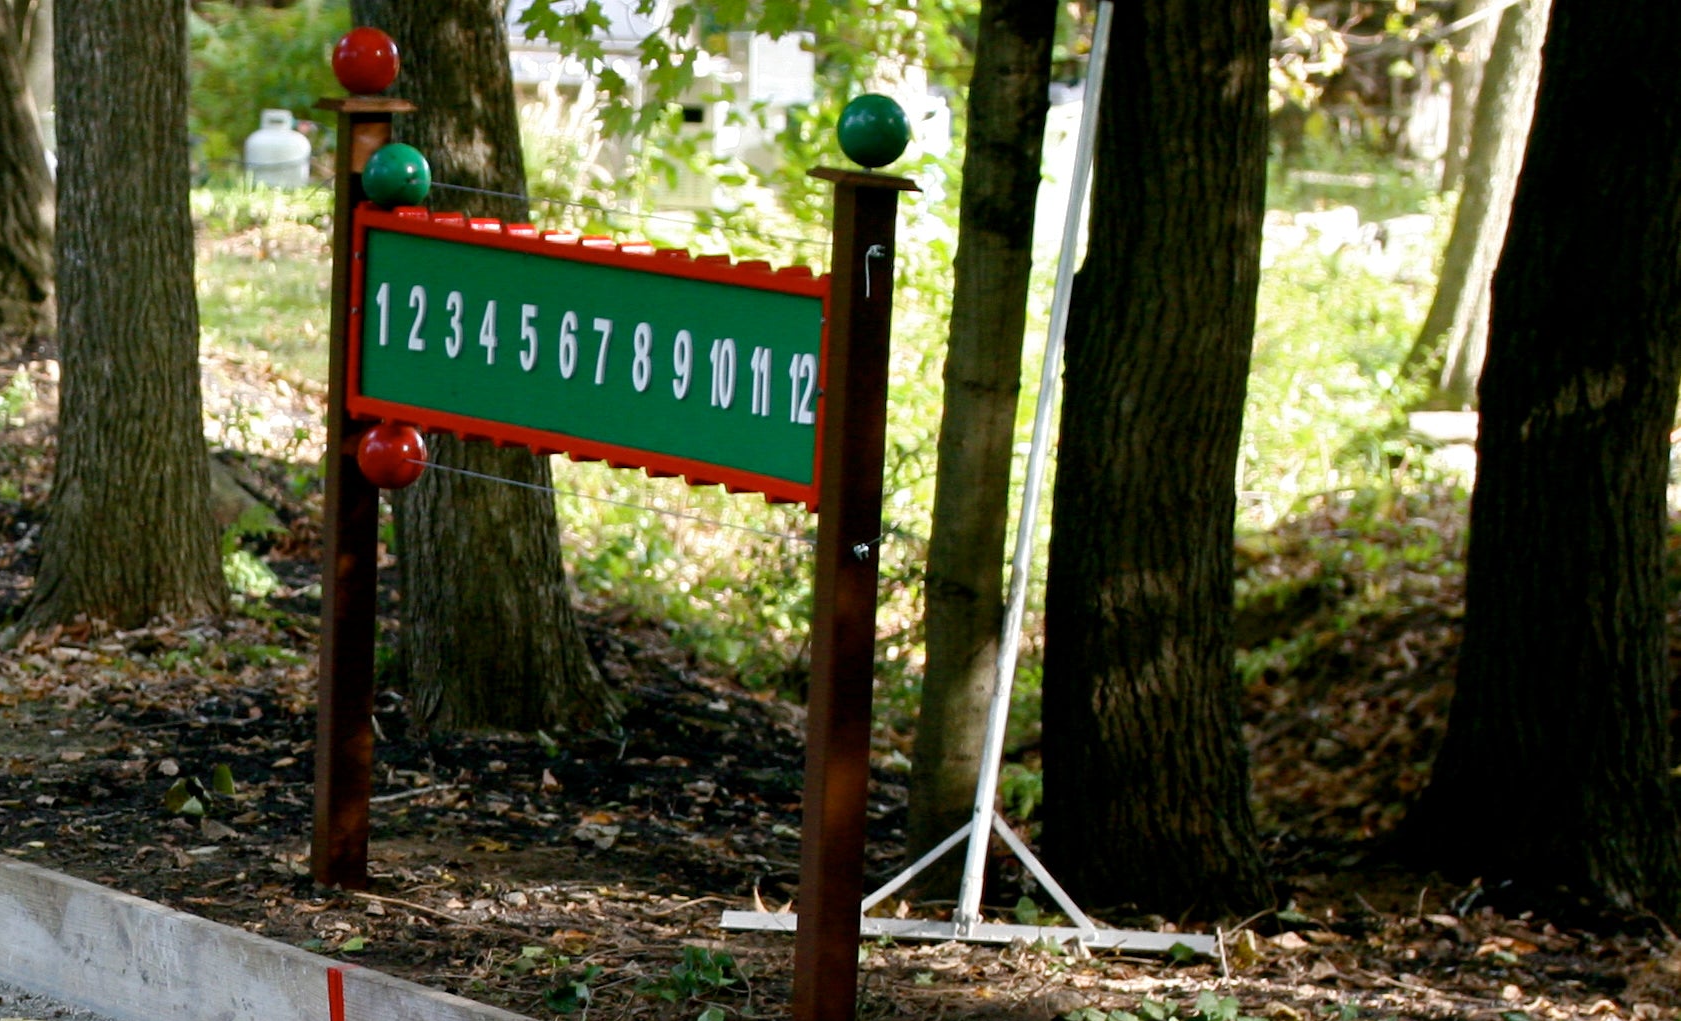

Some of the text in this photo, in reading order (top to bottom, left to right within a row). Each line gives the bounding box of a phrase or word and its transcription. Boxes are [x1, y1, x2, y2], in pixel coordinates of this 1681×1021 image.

[376, 282, 817, 424] 1 2 3 4 5 6 7 8 9 10 11 12
